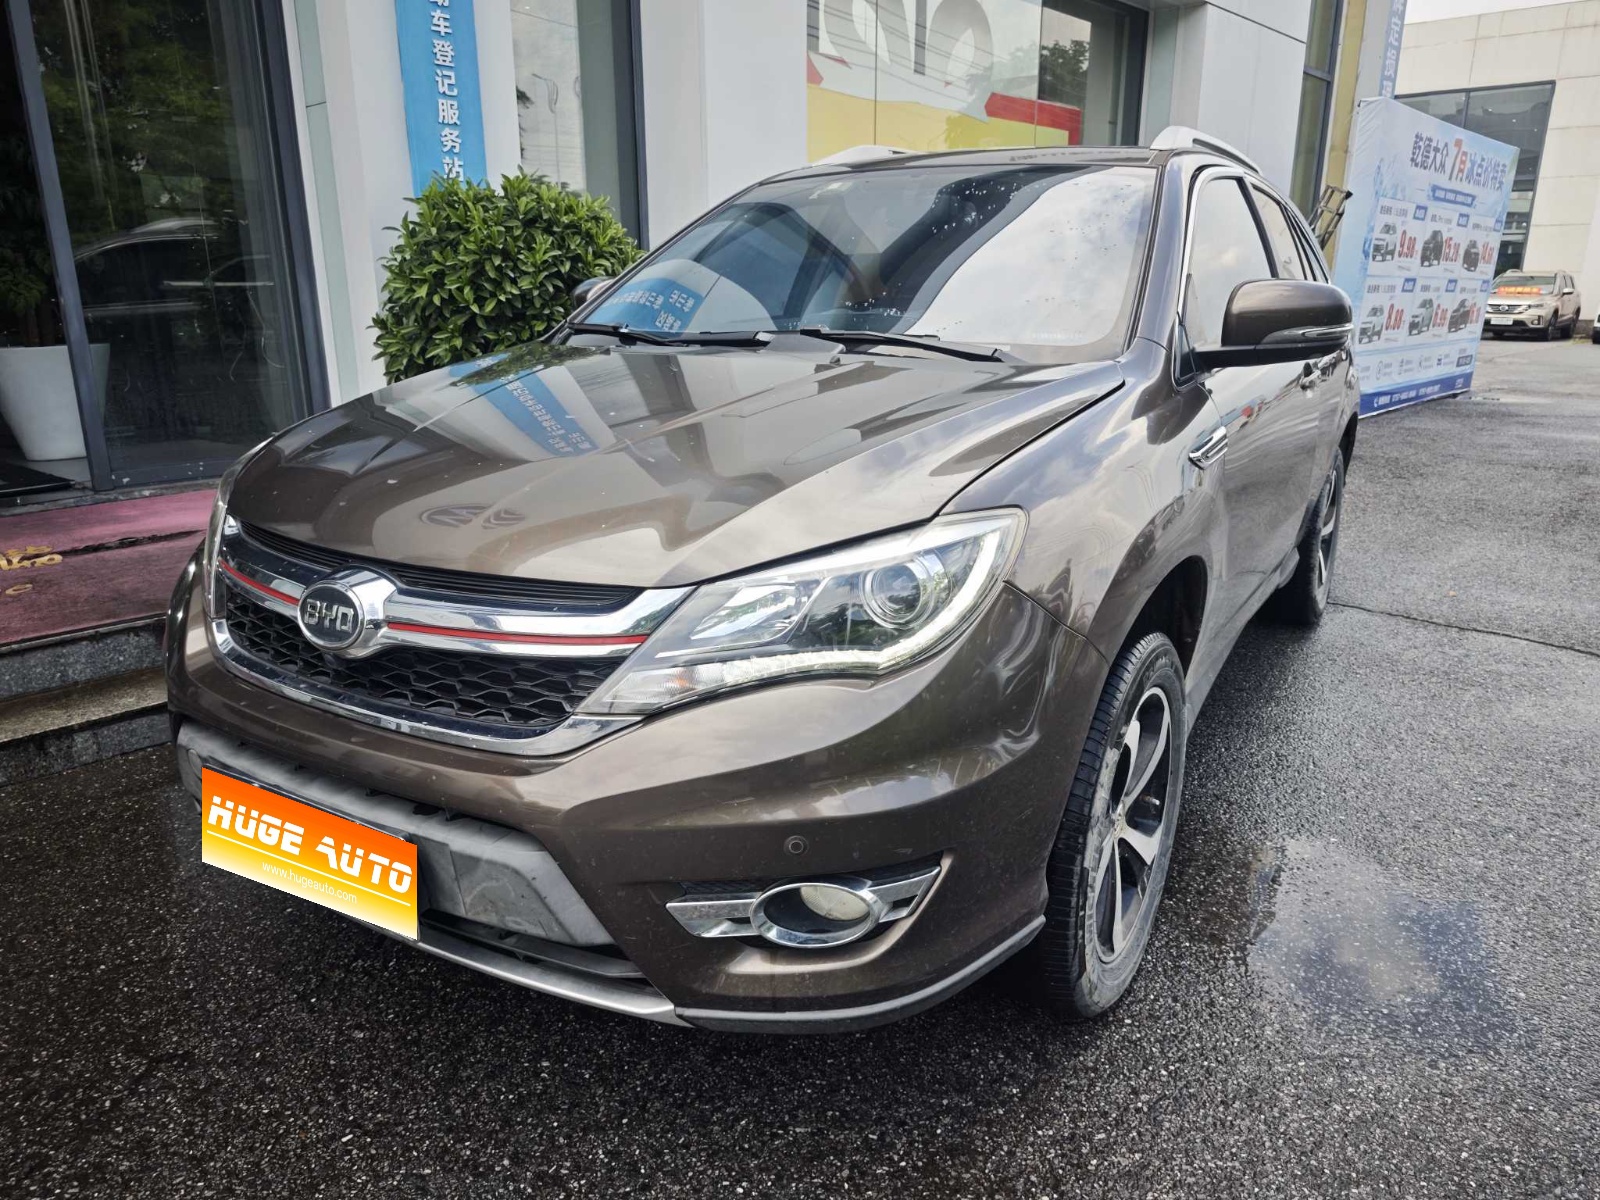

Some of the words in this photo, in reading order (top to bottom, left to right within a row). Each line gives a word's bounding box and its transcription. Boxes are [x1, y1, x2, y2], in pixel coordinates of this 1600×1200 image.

[429, 0, 464, 181] 车登记服务站
[304, 598, 354, 633] BYD
